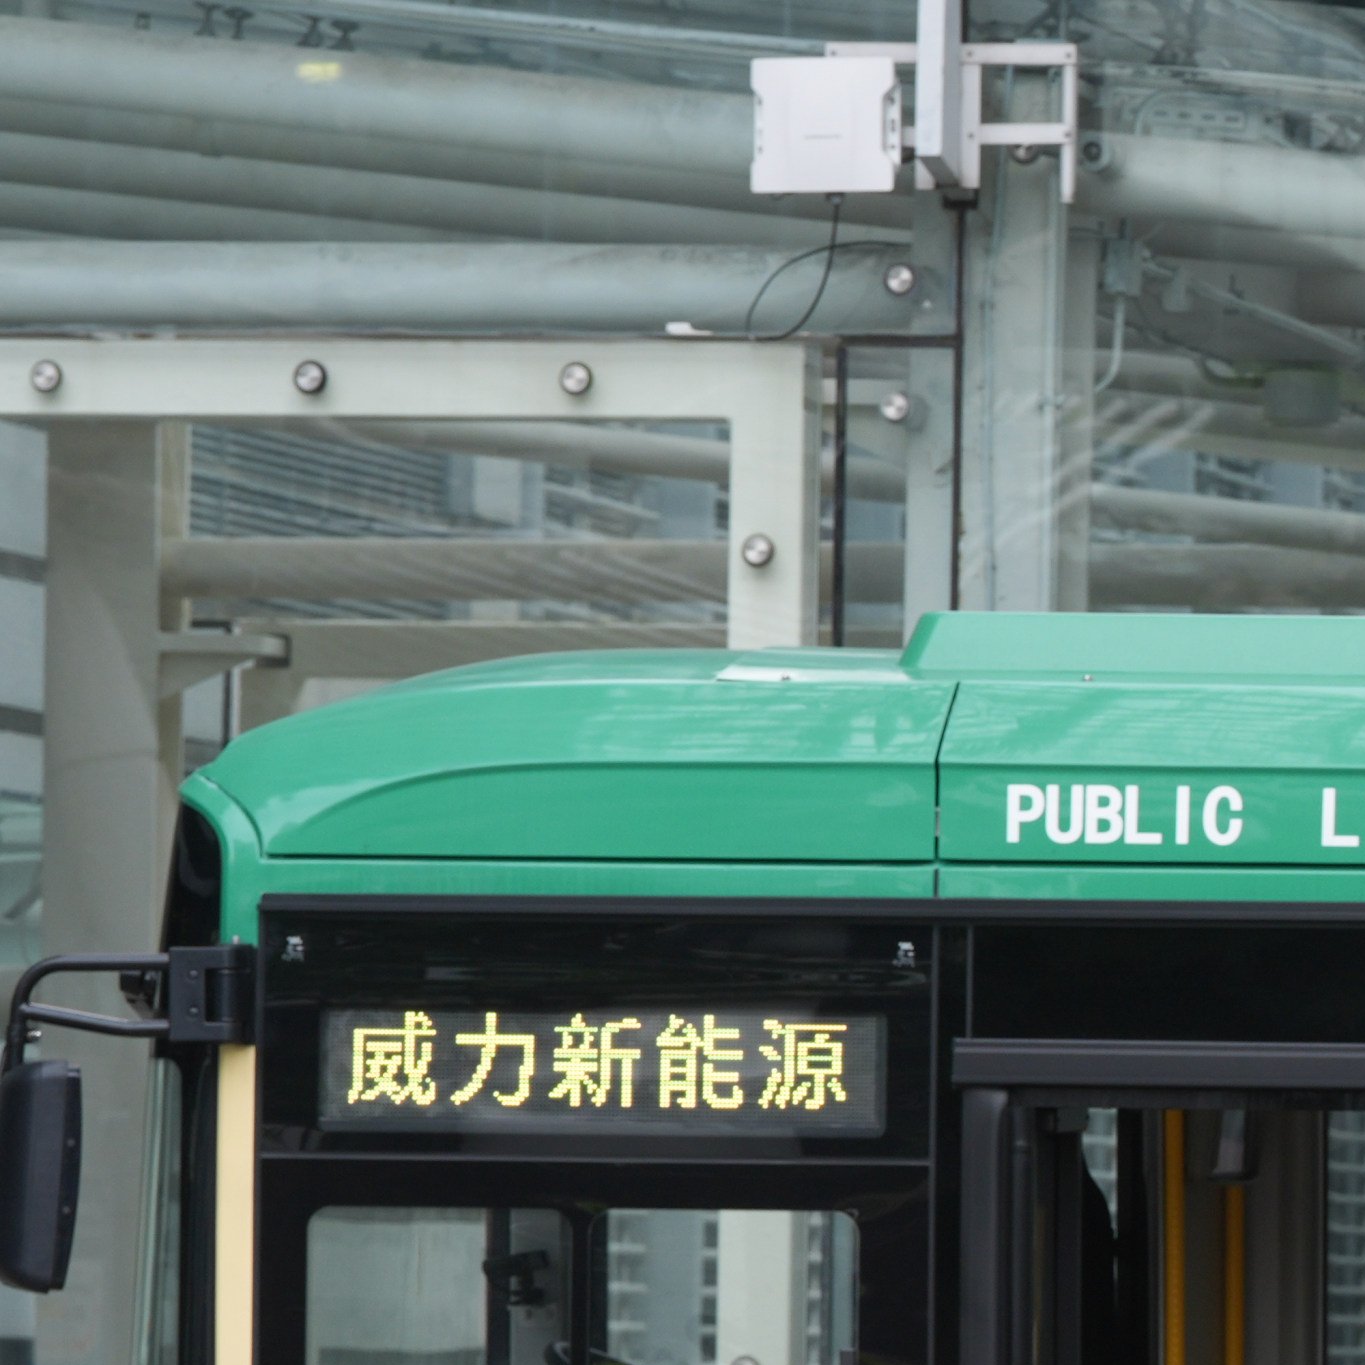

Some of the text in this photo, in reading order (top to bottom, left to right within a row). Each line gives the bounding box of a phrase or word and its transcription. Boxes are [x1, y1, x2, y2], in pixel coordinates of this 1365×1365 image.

[1006, 784, 1244, 845] PUBLIC
[347, 1011, 848, 1110] 威力新能源
